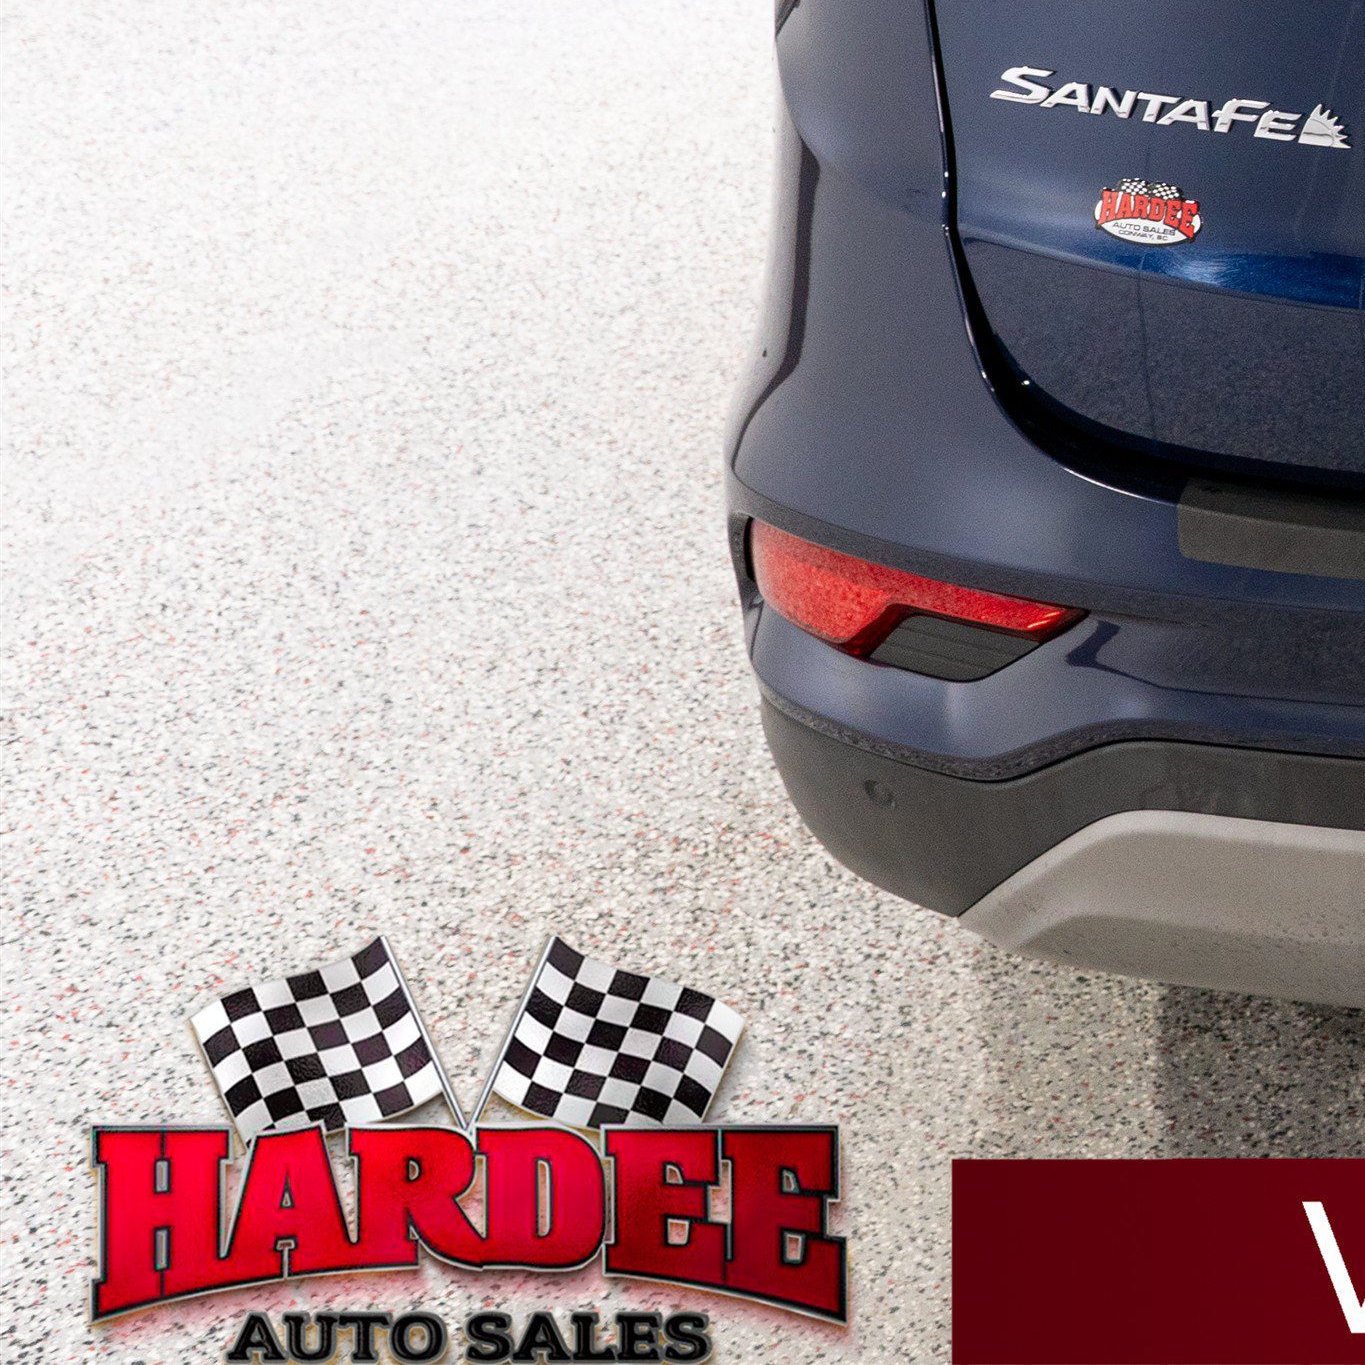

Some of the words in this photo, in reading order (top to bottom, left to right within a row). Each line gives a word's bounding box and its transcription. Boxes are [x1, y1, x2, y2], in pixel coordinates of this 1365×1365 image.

[1097, 190, 1198, 239] HARDEE
[1112, 221, 1141, 231] AUTO
[1143, 226, 1176, 236] SALES
